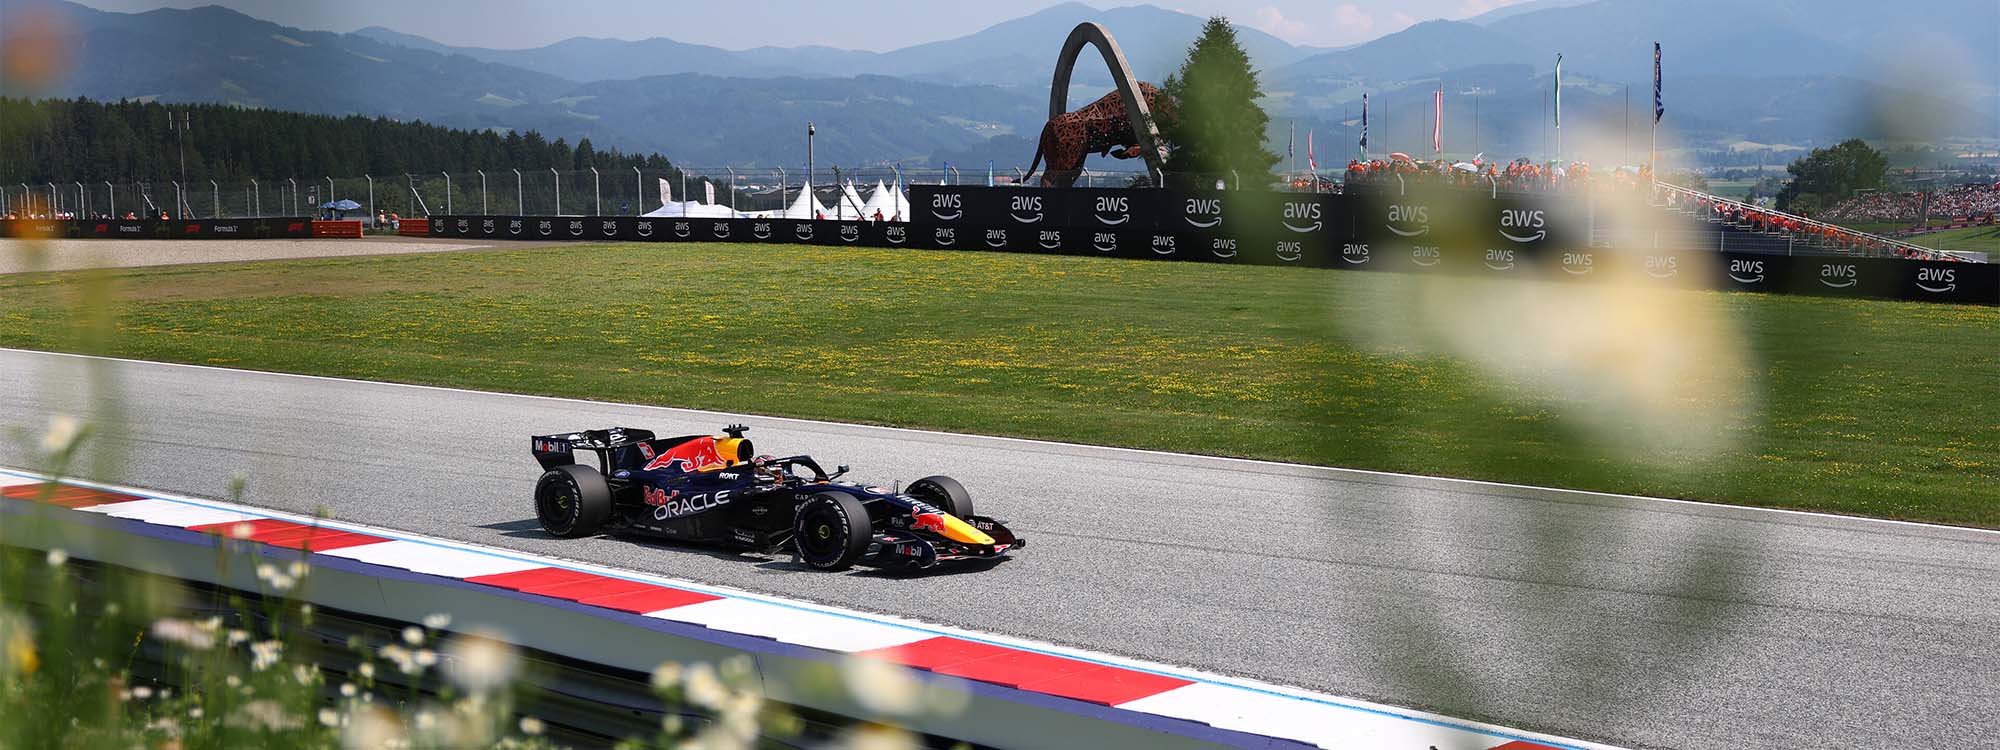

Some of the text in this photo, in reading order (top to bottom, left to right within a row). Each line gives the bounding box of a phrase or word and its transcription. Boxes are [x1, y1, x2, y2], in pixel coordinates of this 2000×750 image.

[933, 194, 961, 208] aws
[1012, 196, 1041, 210] aws
[1097, 197, 1128, 211] aws
[1187, 199, 1220, 214] aws
[1284, 203, 1320, 218] aws
[1388, 204, 1428, 223] aws
[1501, 209, 1545, 227] aws
[936, 228, 954, 237] aws
[987, 230, 1006, 239] aws
[1040, 231, 1060, 240] aws
[1095, 233, 1115, 243] aws
[1153, 236, 1174, 246] aws
[1214, 239, 1236, 249] aws
[1277, 242, 1300, 252] aws
[1344, 244, 1368, 255] aws
[1486, 250, 1513, 262] aws
[1562, 253, 1593, 266] aws
[1731, 260, 1763, 273] aws
[1822, 265, 1856, 277] aws
[1918, 268, 1954, 282] aws
[535, 440, 559, 453] Mobil
[719, 472, 740, 480] ROKT
[653, 490, 731, 520] ORACLE
[977, 521, 994, 531] AT&T
[895, 543, 922, 557] Mobil
